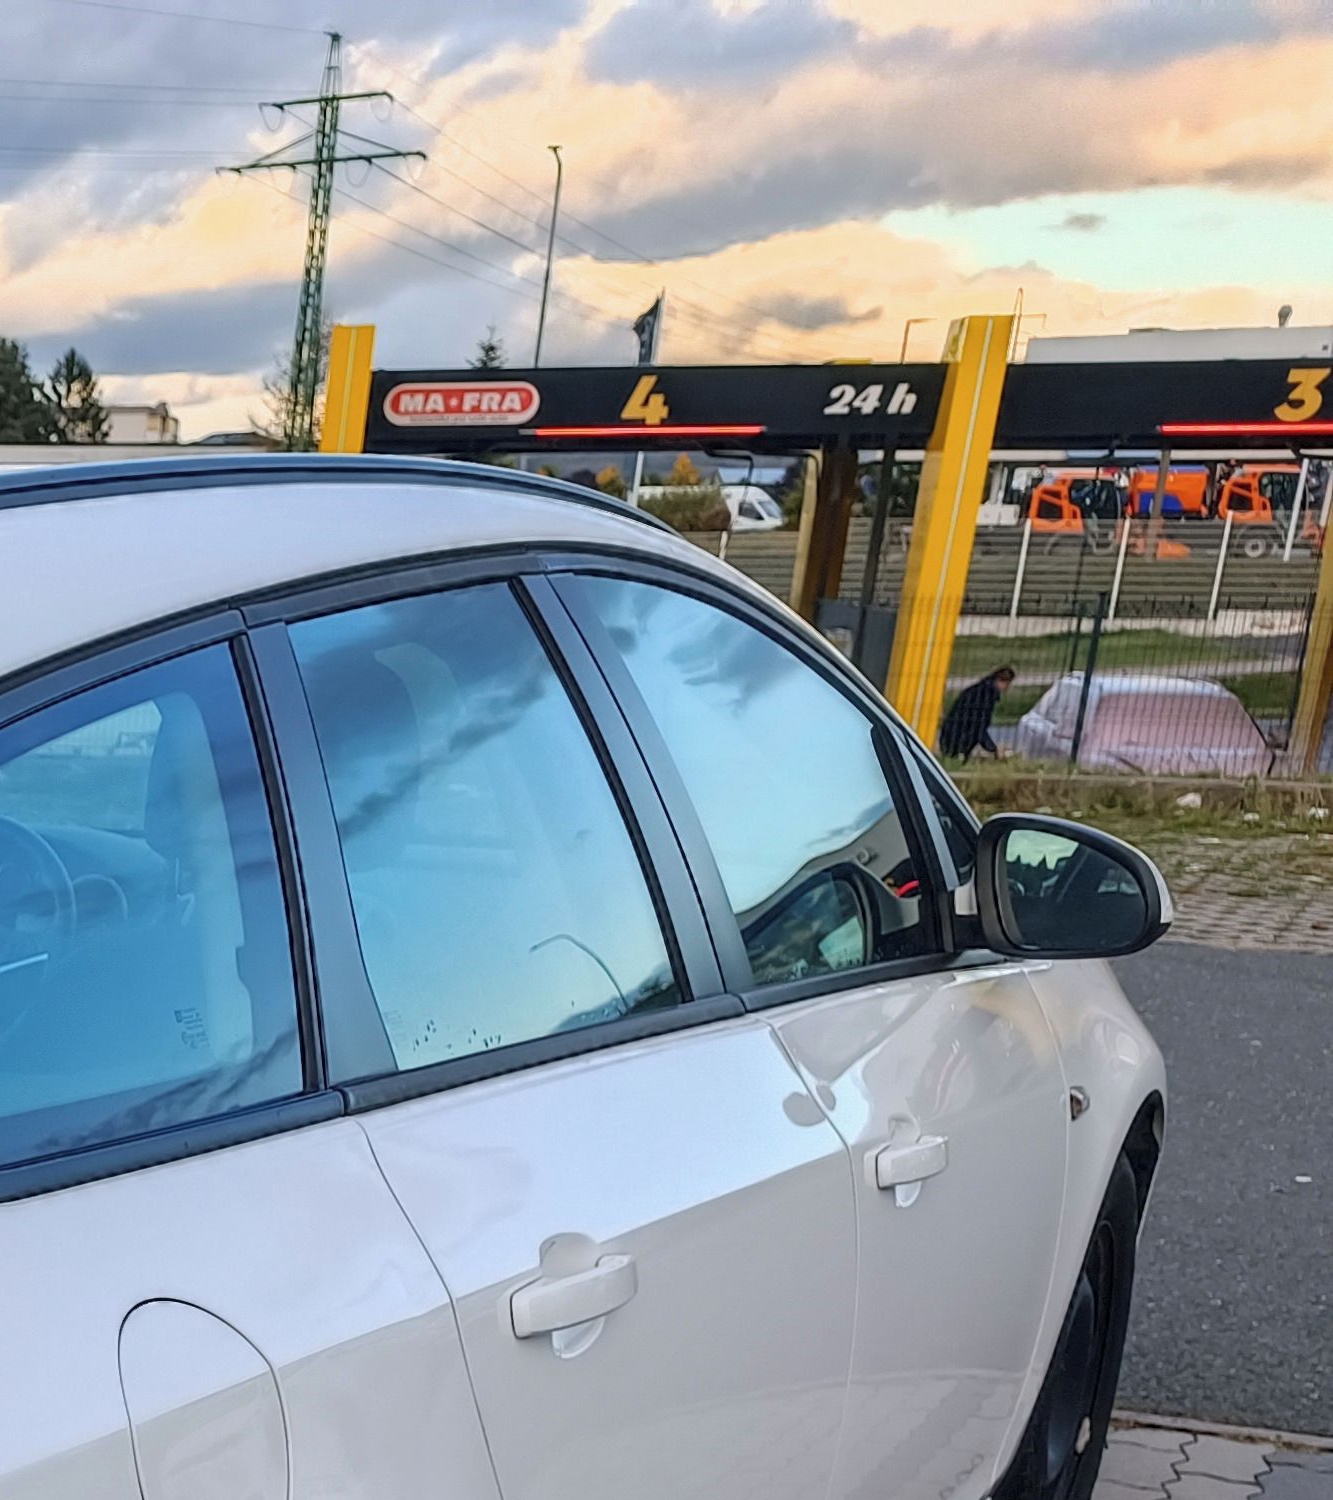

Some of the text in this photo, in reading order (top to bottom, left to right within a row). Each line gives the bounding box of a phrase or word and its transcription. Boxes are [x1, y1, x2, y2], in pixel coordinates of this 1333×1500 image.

[620, 374, 670, 425] 4
[823, 382, 918, 415] 24 h
[1273, 367, 1332, 422] 3
